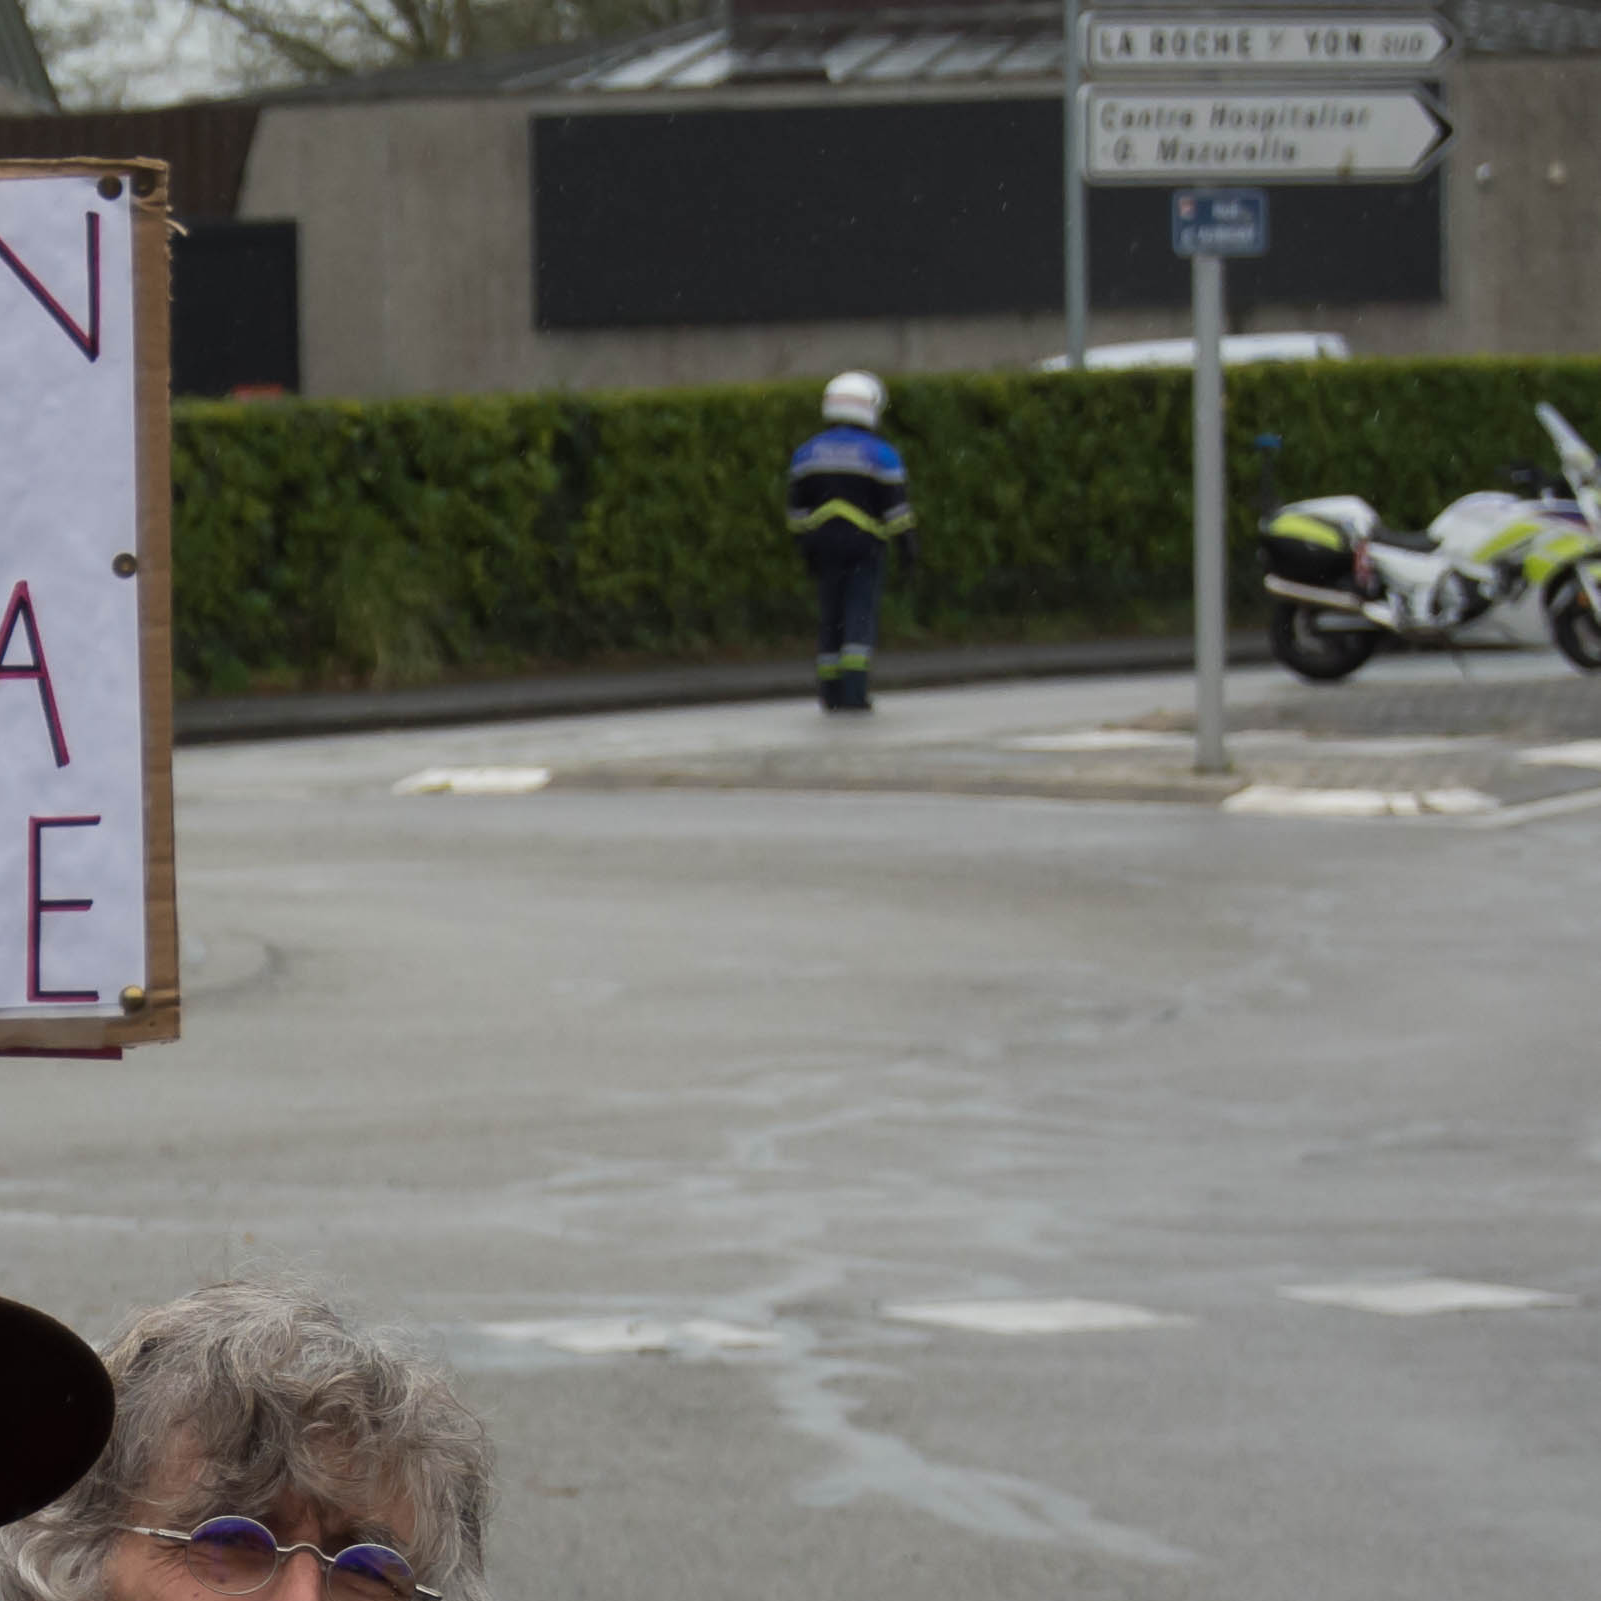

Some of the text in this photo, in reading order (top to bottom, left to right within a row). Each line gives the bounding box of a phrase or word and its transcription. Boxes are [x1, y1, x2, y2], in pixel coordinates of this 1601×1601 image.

[1100, 27, 1134, 57] LA
[1149, 27, 1254, 57] ROCHE
[1304, 29, 1365, 57] YON
